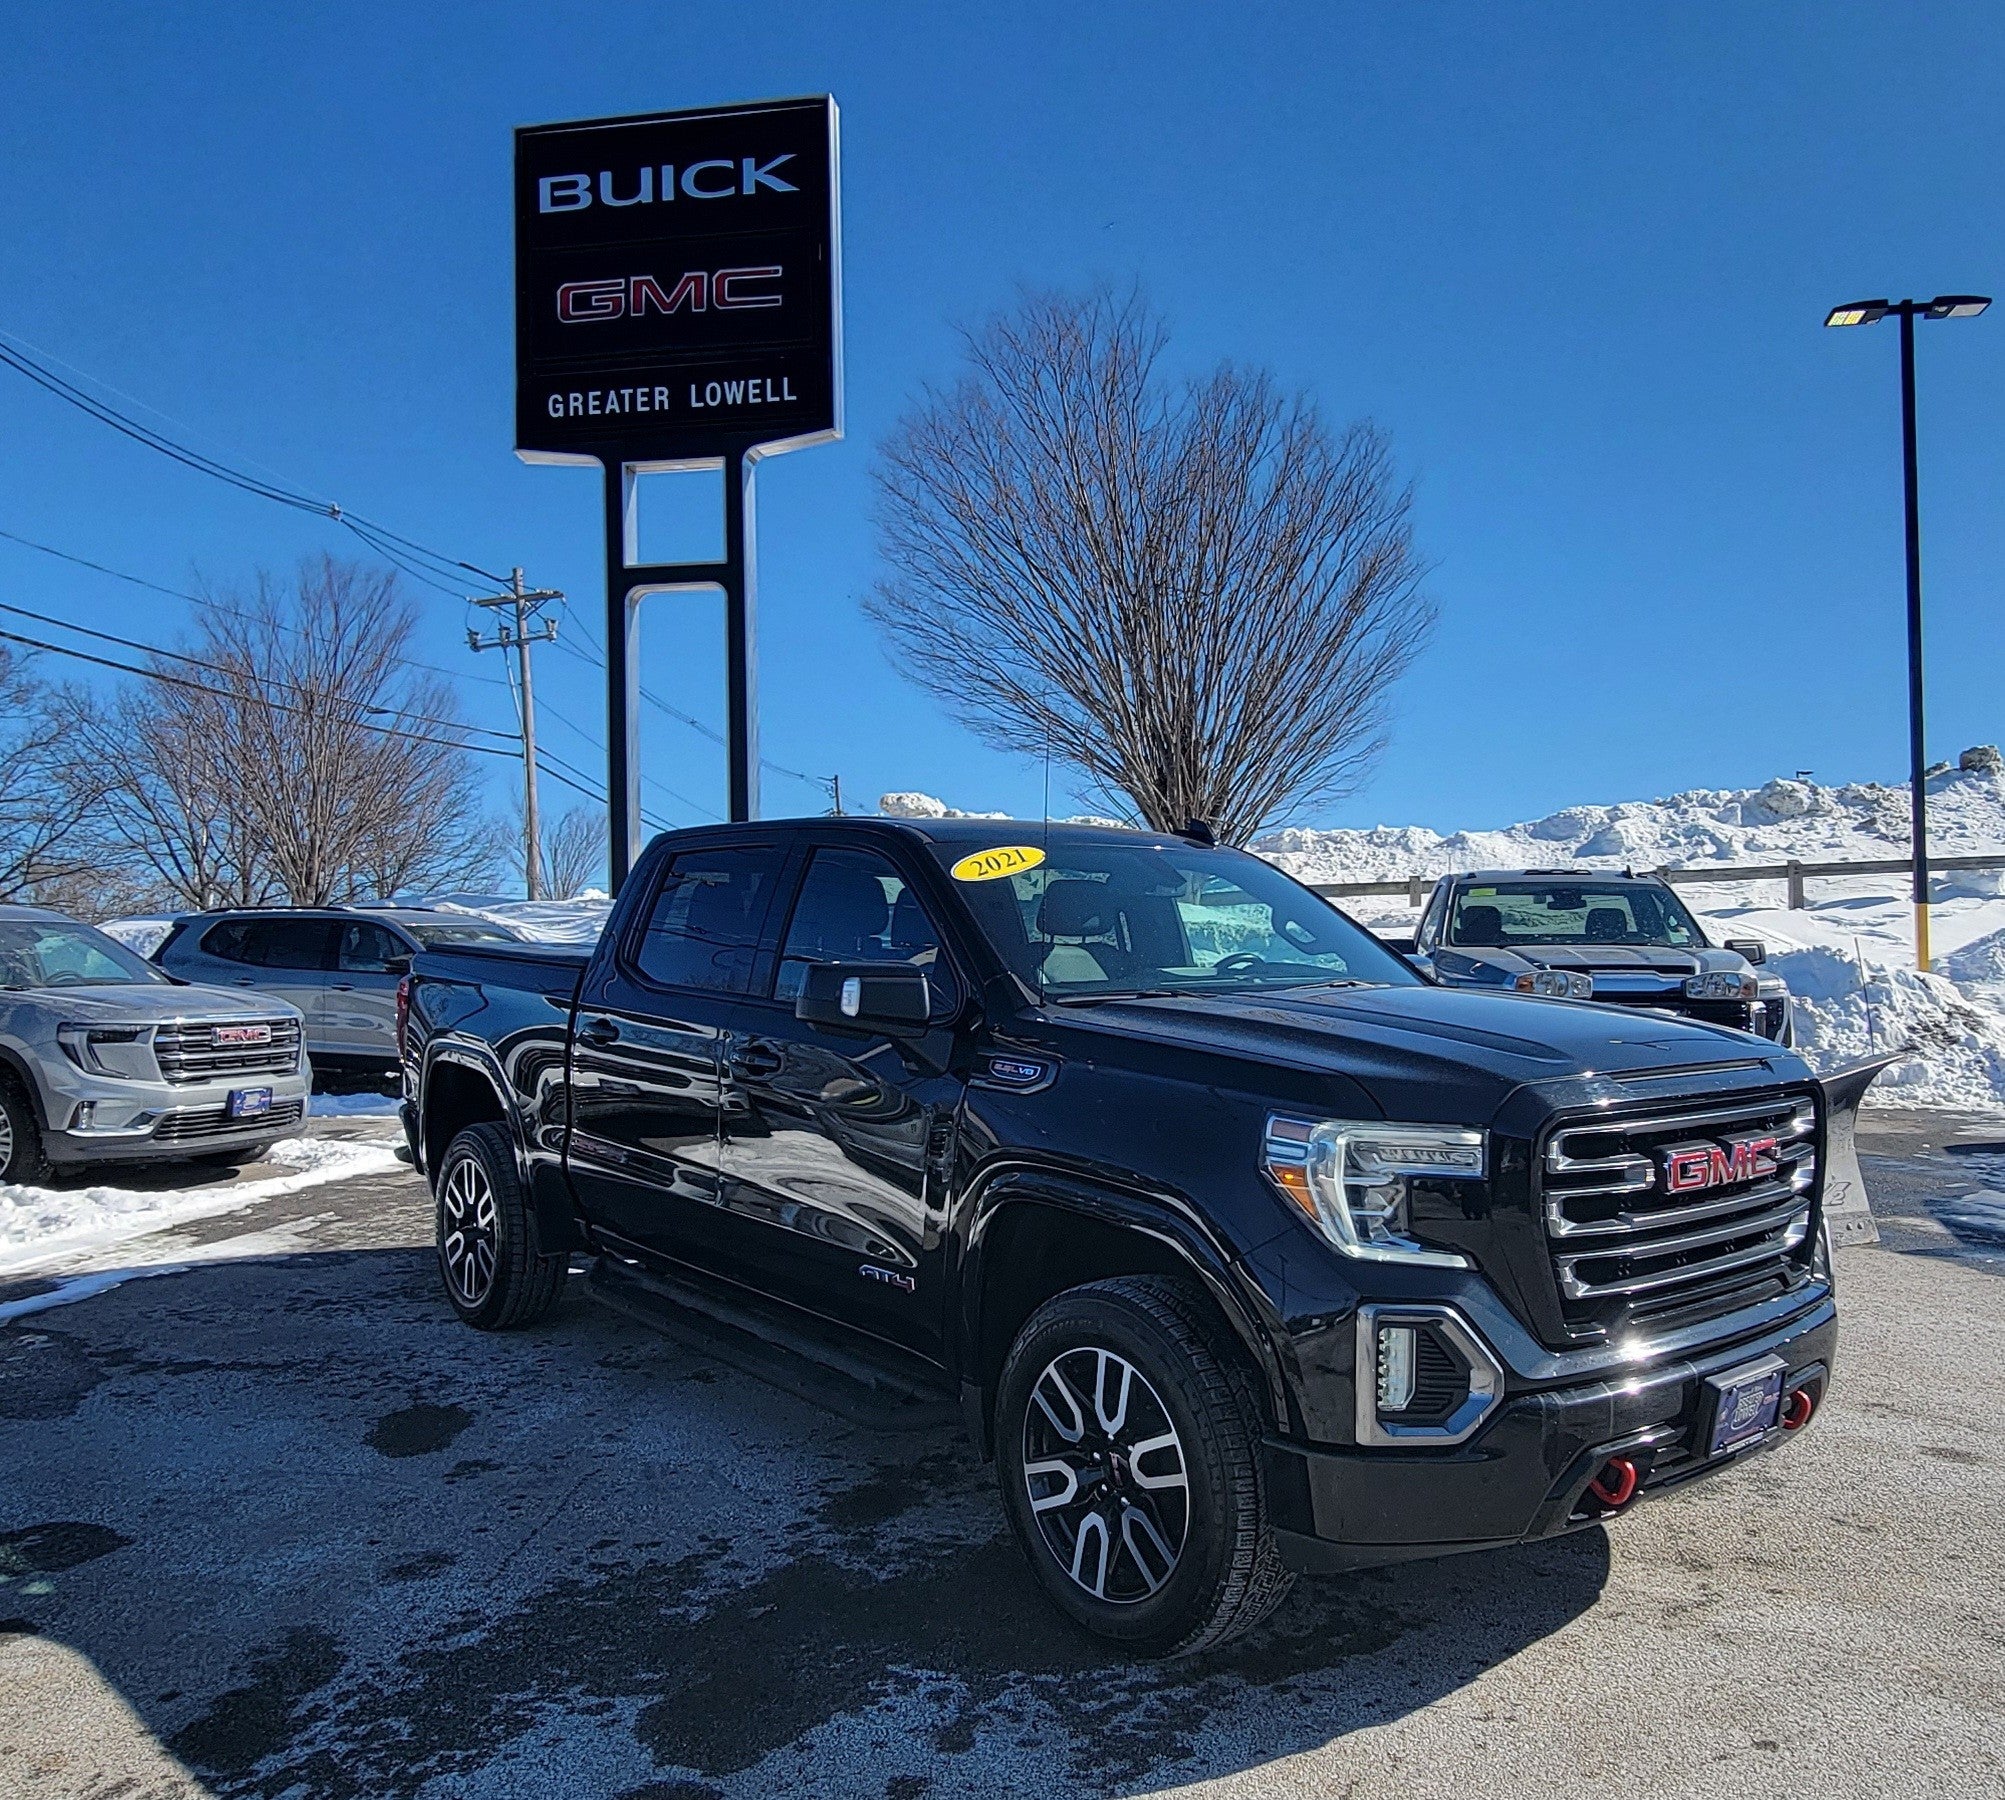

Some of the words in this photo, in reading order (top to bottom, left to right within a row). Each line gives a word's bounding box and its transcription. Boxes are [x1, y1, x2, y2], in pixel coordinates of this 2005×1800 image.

[539, 154, 800, 214] BUICK
[557, 265, 782, 323] GMC
[548, 386, 669, 418] GREATER
[690, 377, 797, 408] LOWELL
[969, 848, 1029, 877] 2021
[1667, 1137, 1777, 1193] GMC
[859, 1264, 915, 1294] AT4
